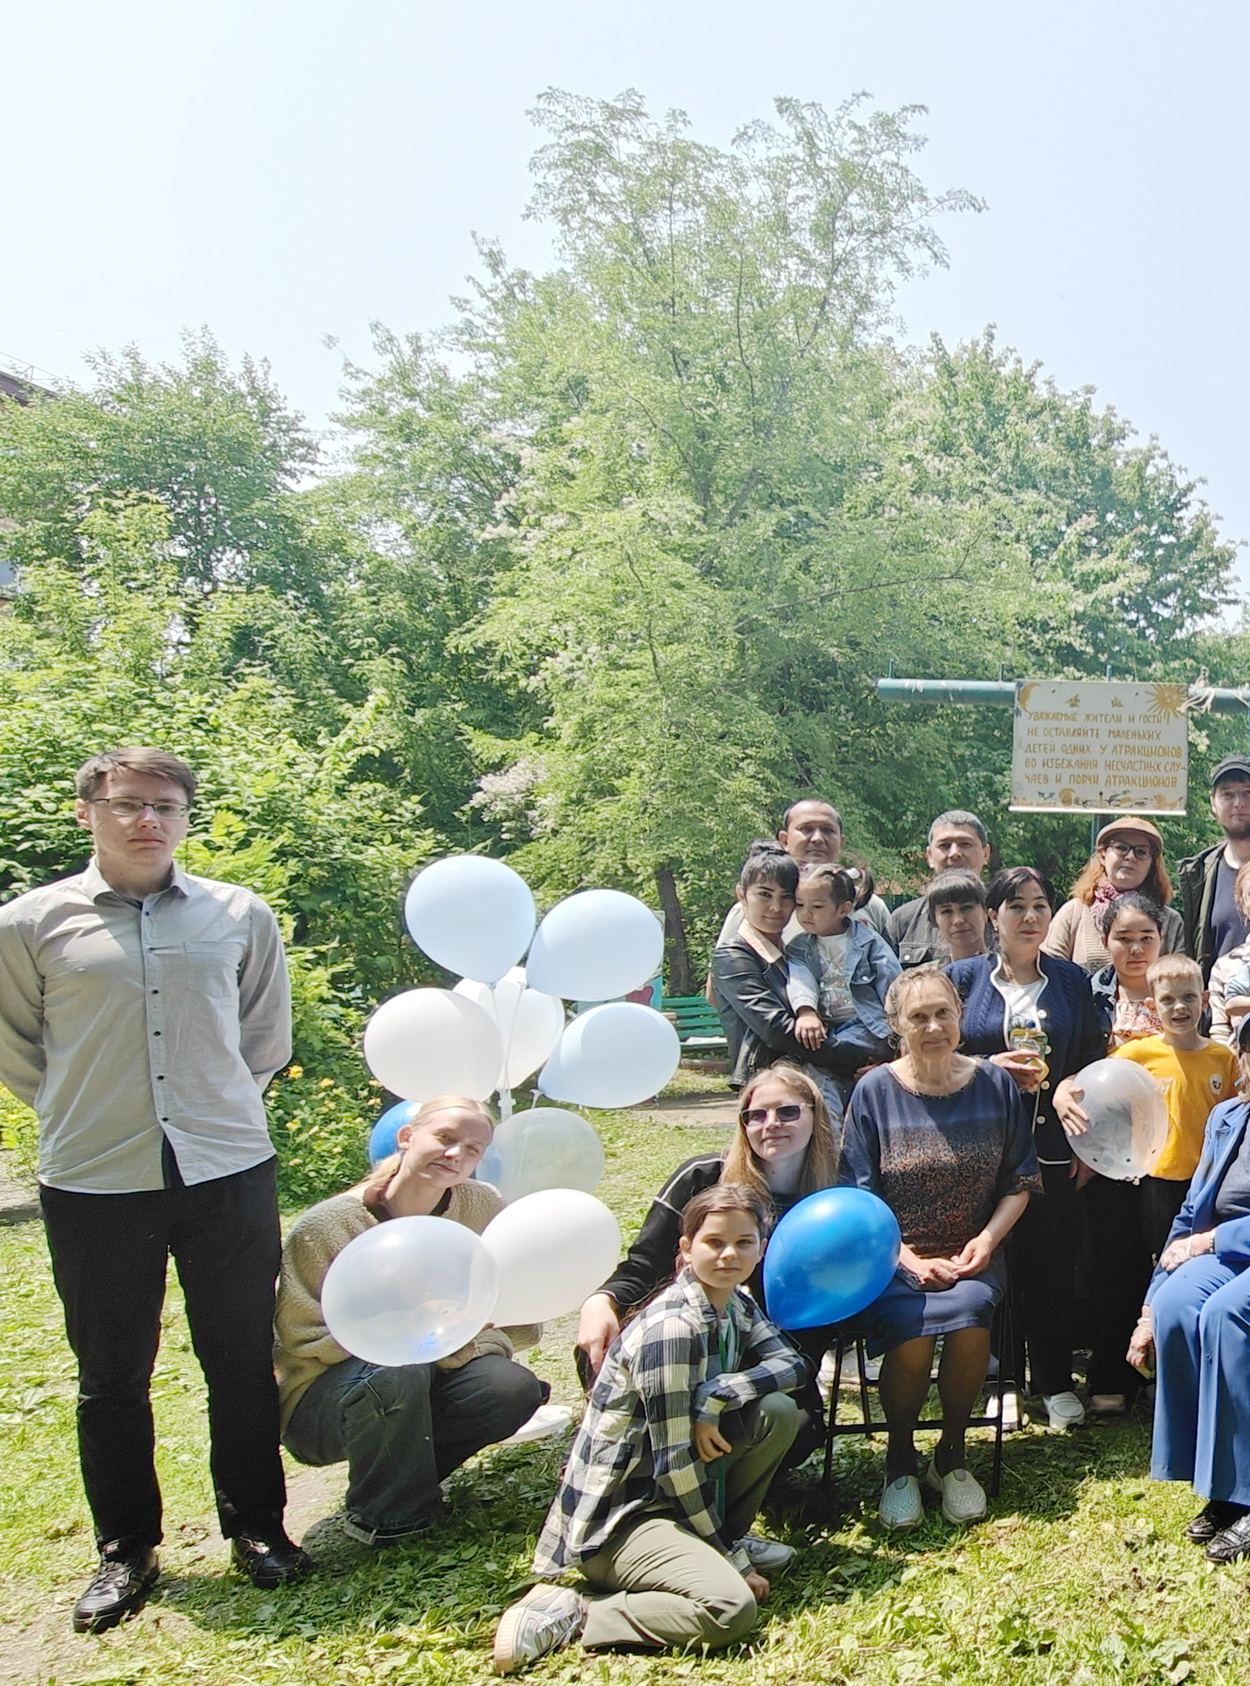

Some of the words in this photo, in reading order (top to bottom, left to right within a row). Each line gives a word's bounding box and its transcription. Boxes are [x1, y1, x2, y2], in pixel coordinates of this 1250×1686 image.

[1084, 713, 1122, 723] ЖИТЕЛИ
[1128, 714, 1135, 724] И
[1027, 727, 1039, 737] НЕ
[1108, 728, 1162, 741] МАЛЕНЬКИХ
[1061, 743, 1092, 755] ОДНИХ
[1100, 745, 1108, 755] У
[1112, 744, 1183, 759] АТРАКЦИОНОВ
[1024, 757, 1037, 769] ВО
[1042, 757, 1099, 770] ИЗБЕЖАНИЯ
[1104, 759, 1161, 772] НЕСЧАСТНЫХ
[1024, 773, 1049, 785] ЧАЕВ
[1055, 773, 1062, 784] И
[1069, 773, 1100, 786] ПОРЧИ
[1105, 774, 1178, 788] АТРАКЦИОНОВ
